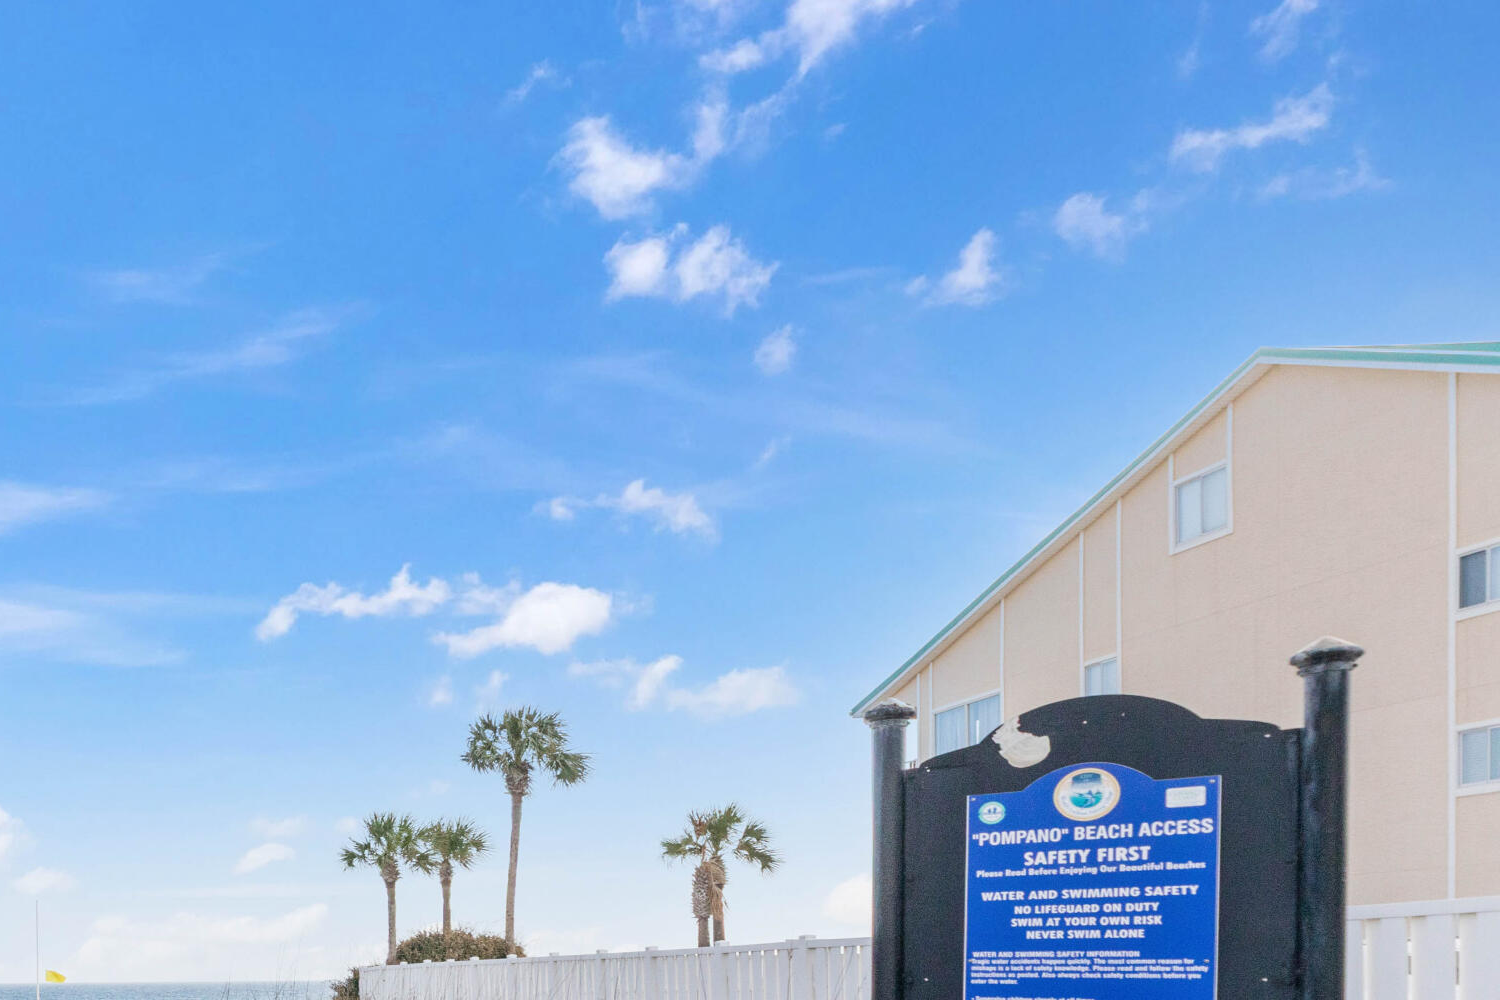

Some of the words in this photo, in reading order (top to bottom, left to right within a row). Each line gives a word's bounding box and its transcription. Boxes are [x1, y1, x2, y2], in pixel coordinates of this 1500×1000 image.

[972, 828, 1069, 846] "POMPANO"
[1074, 824, 1133, 841] BEACH
[1138, 818, 1214, 837] ACCESS
[1023, 849, 1091, 866] SAFETY
[1097, 846, 1151, 862] FIRST
[976, 869, 1004, 878] Please
[1005, 868, 1026, 877] Read
[1028, 867, 1058, 876] Before
[1059, 866, 1098, 876] Enjoying
[1100, 864, 1117, 872] Our
[1119, 862, 1164, 872] Beautiful
[1165, 861, 1206, 870] Beaches
[981, 891, 1025, 902] WATER
[1028, 890, 1058, 900] AND
[1062, 887, 1141, 899] SWIMMING
[1144, 884, 1199, 896] SAFETY
[1014, 906, 1032, 915] NO
[1034, 904, 1100, 914] LIFEGUARD
[1103, 903, 1123, 912] ON
[1125, 902, 1160, 912] DUTY
[1010, 918, 1043, 927] SWIM
[1045, 918, 1061, 927] AT
[1064, 916, 1098, 926] YOUR
[1100, 916, 1130, 926] OWN
[1134, 915, 1163, 925] RISK
[1026, 930, 1064, 940] NEVER
[1067, 930, 1101, 940] SWIM
[1104, 929, 1146, 939] ALONE
